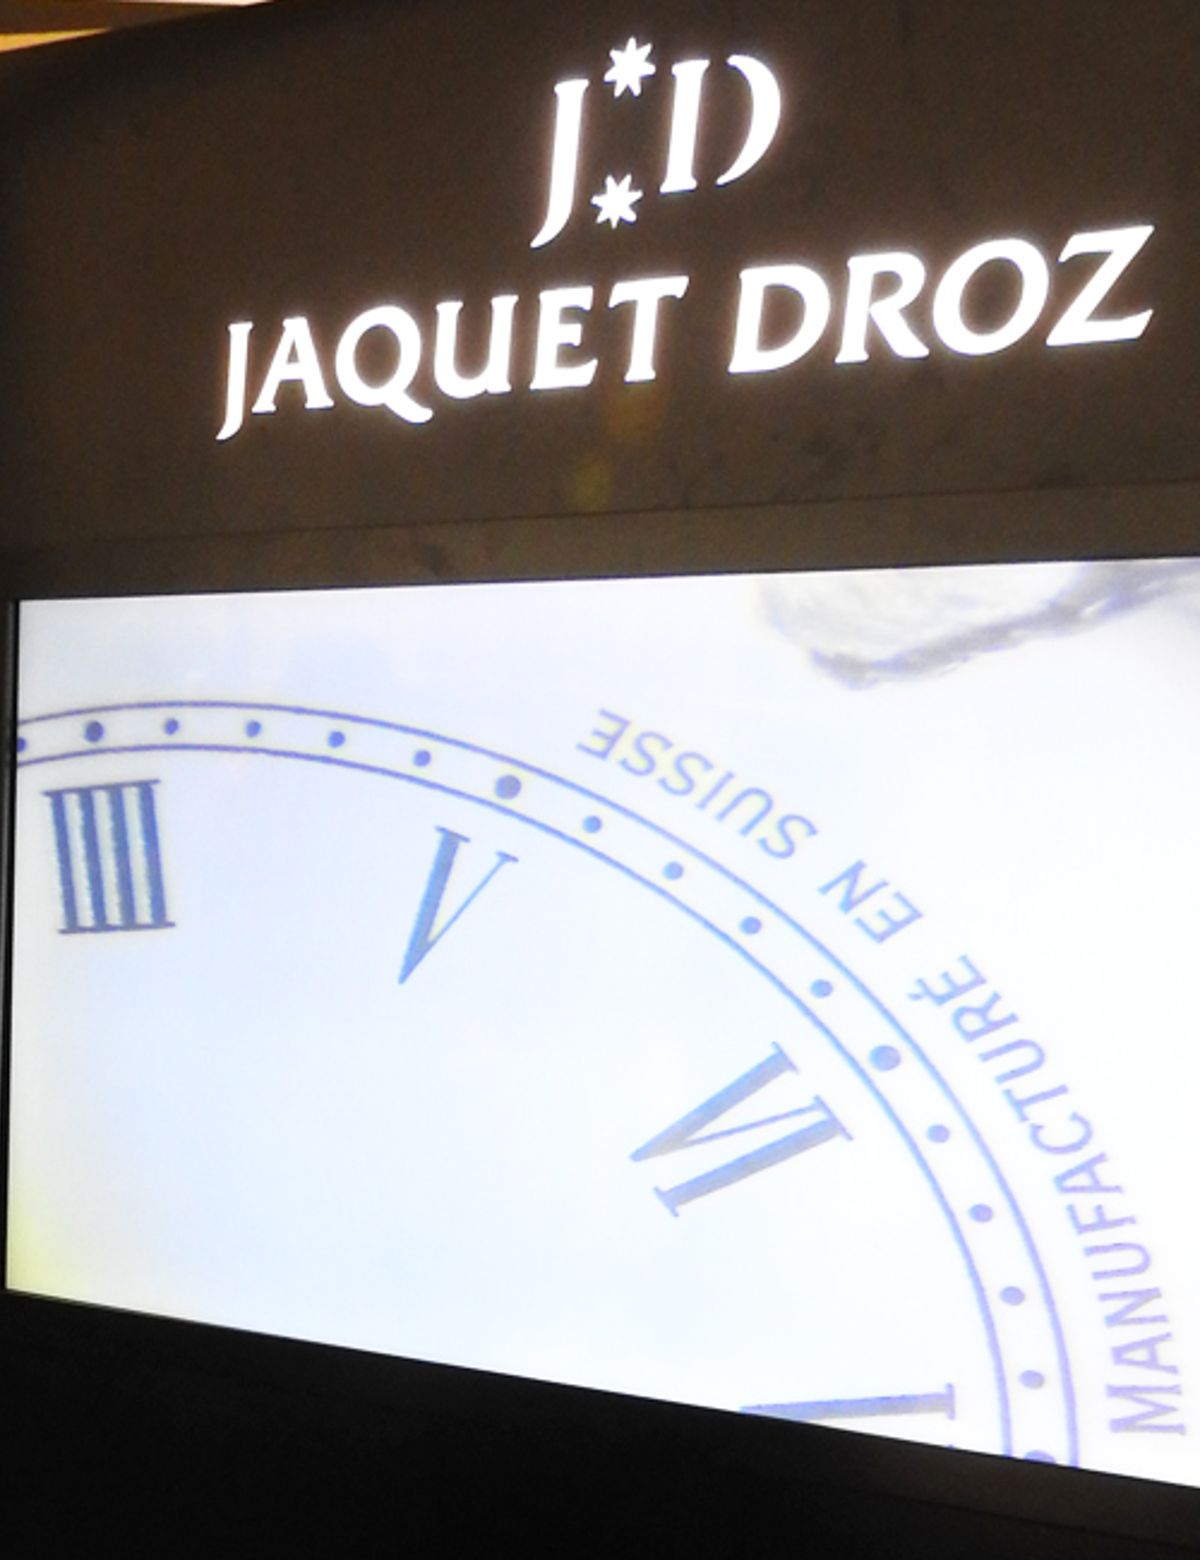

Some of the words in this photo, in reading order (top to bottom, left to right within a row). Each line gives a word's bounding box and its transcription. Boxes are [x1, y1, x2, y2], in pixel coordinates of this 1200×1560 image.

[216, 275, 689, 440] JAQUET
[728, 225, 1154, 374] DROZ
[575, 708, 819, 860] SUISSE
[816, 859, 923, 945] EN
